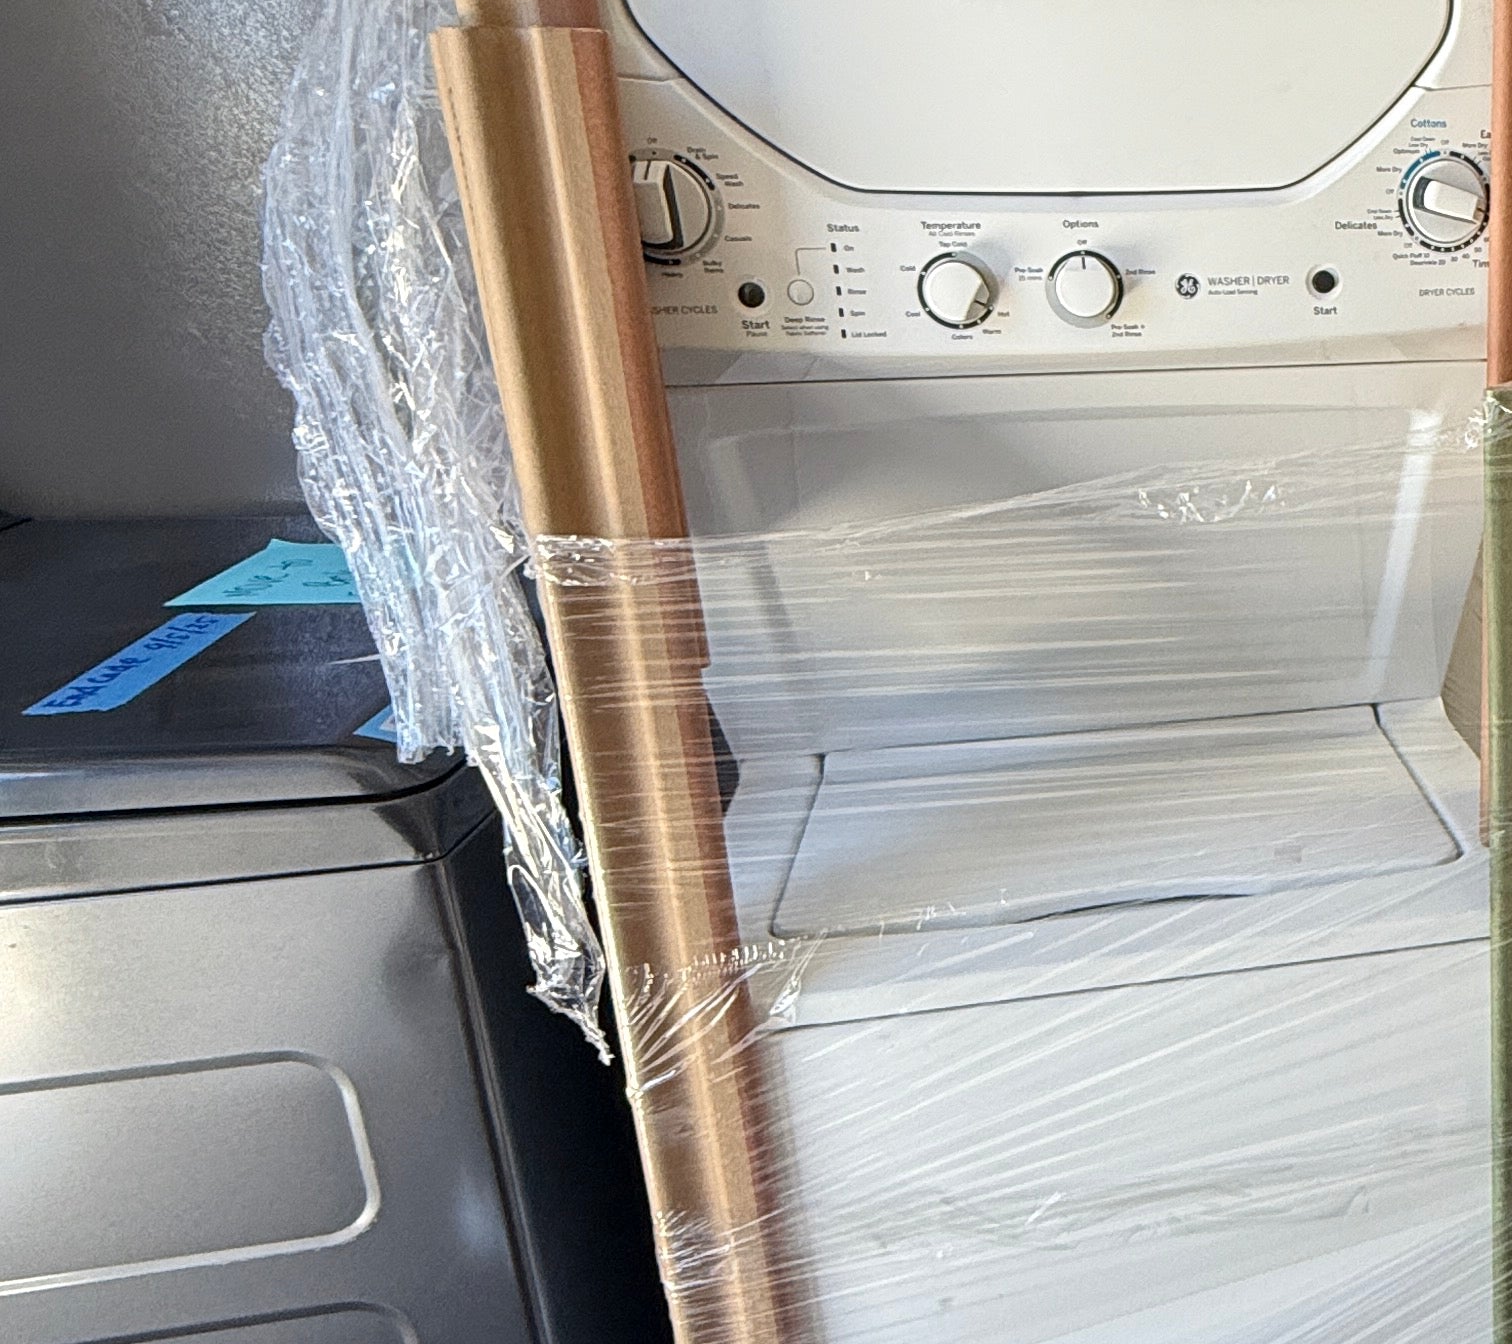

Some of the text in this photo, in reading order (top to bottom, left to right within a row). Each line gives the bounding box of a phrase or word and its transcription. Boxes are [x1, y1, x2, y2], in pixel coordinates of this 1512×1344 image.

[1410, 118, 1447, 129] Cottons
[827, 223, 860, 232] Status
[920, 221, 981, 232] Temperature
[1063, 220, 1099, 229] Options
[1335, 221, 1378, 230] Delicates
[1207, 276, 1250, 286] WASHER
[1257, 275, 1290, 286] DRYER
[1314, 306, 1337, 315] Start
[741, 320, 770, 329] Start
